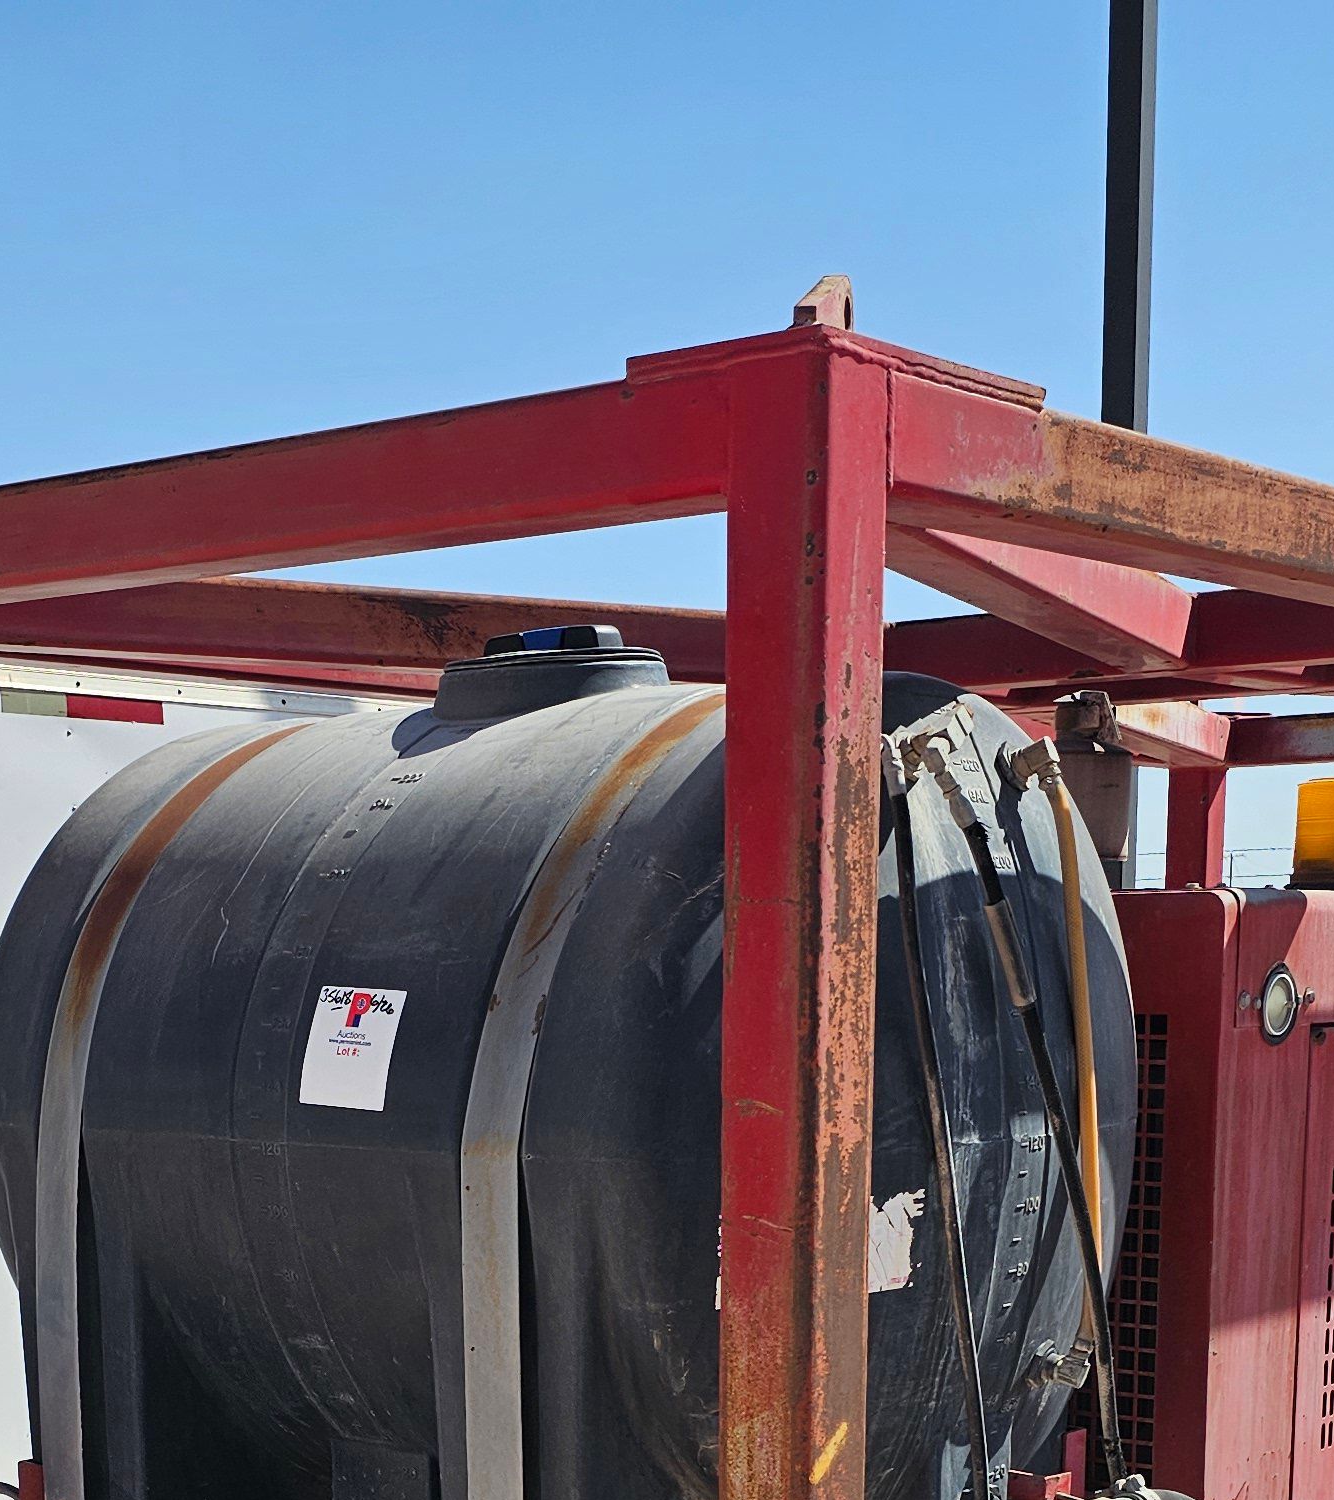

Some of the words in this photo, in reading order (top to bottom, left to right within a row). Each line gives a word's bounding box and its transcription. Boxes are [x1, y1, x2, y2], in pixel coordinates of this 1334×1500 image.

[337, 1030, 366, 1040] Auctions
[336, 1046, 350, 1056] Lot
[1022, 1197, 1041, 1216] 100
[1016, 1262, 1030, 1278] 80
